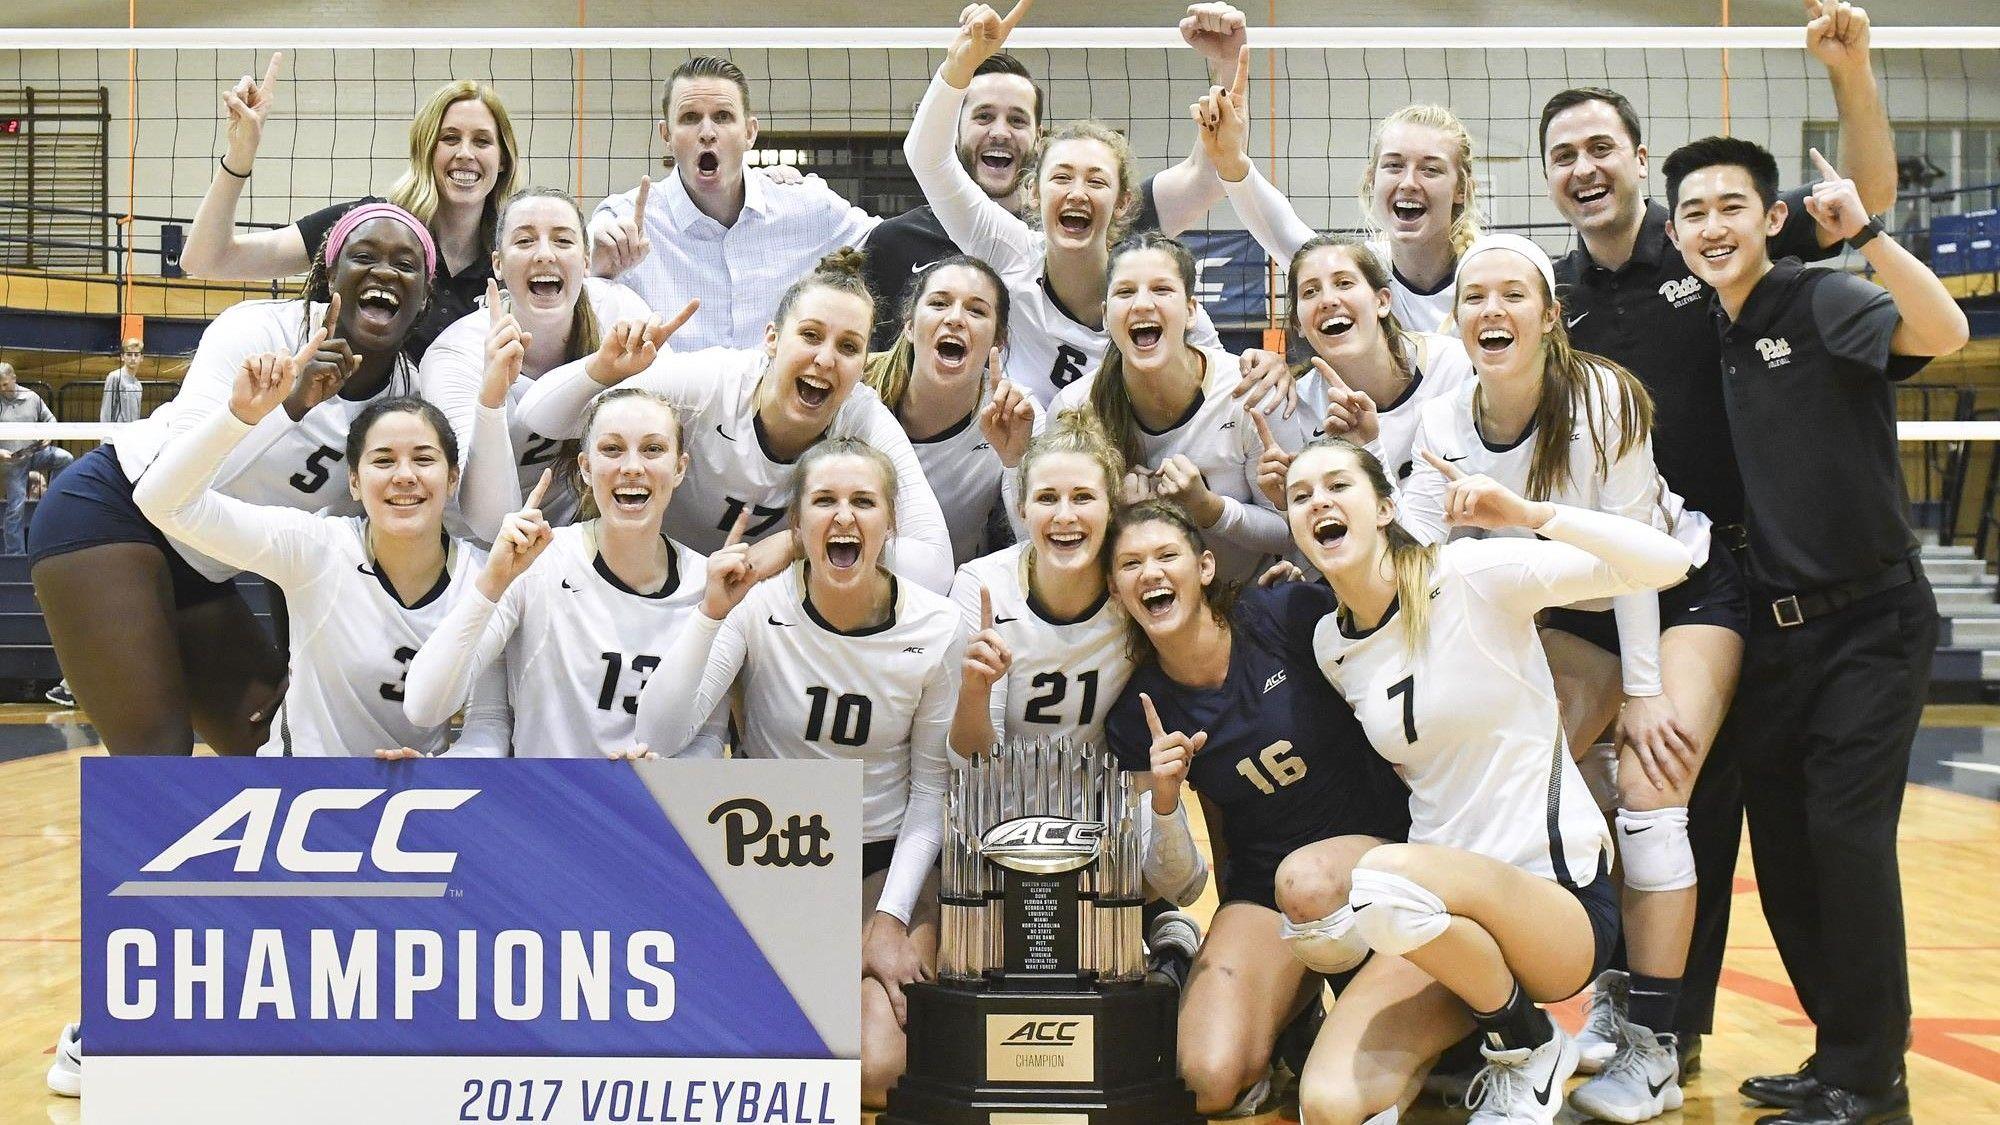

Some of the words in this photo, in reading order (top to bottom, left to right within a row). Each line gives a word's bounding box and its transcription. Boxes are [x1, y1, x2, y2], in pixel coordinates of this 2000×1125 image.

[1658, 275, 1702, 303] Pitt
[1050, 344, 1088, 389] 6
[1754, 337, 1792, 362] Pitt
[289, 445, 344, 494] 5
[716, 495, 788, 537] 17
[902, 646, 925, 654] ACC
[597, 651, 662, 715] 13
[1024, 669, 1099, 725] 21
[1263, 669, 1287, 692] ACC
[805, 686, 872, 747] 10
[1386, 674, 1418, 745] 7
[1235, 739, 1308, 795] 16
[139, 788, 483, 873] ACC
[707, 797, 835, 868] Pitt
[992, 821, 1107, 845] ACC
[106, 928, 677, 1022] CHAMPIONS
[1007, 1021, 1081, 1041] ACC
[1015, 1054, 1065, 1068] CHAMPION
[458, 1078, 563, 1122] 2017
[580, 1079, 837, 1125] VOLLEYBALL
